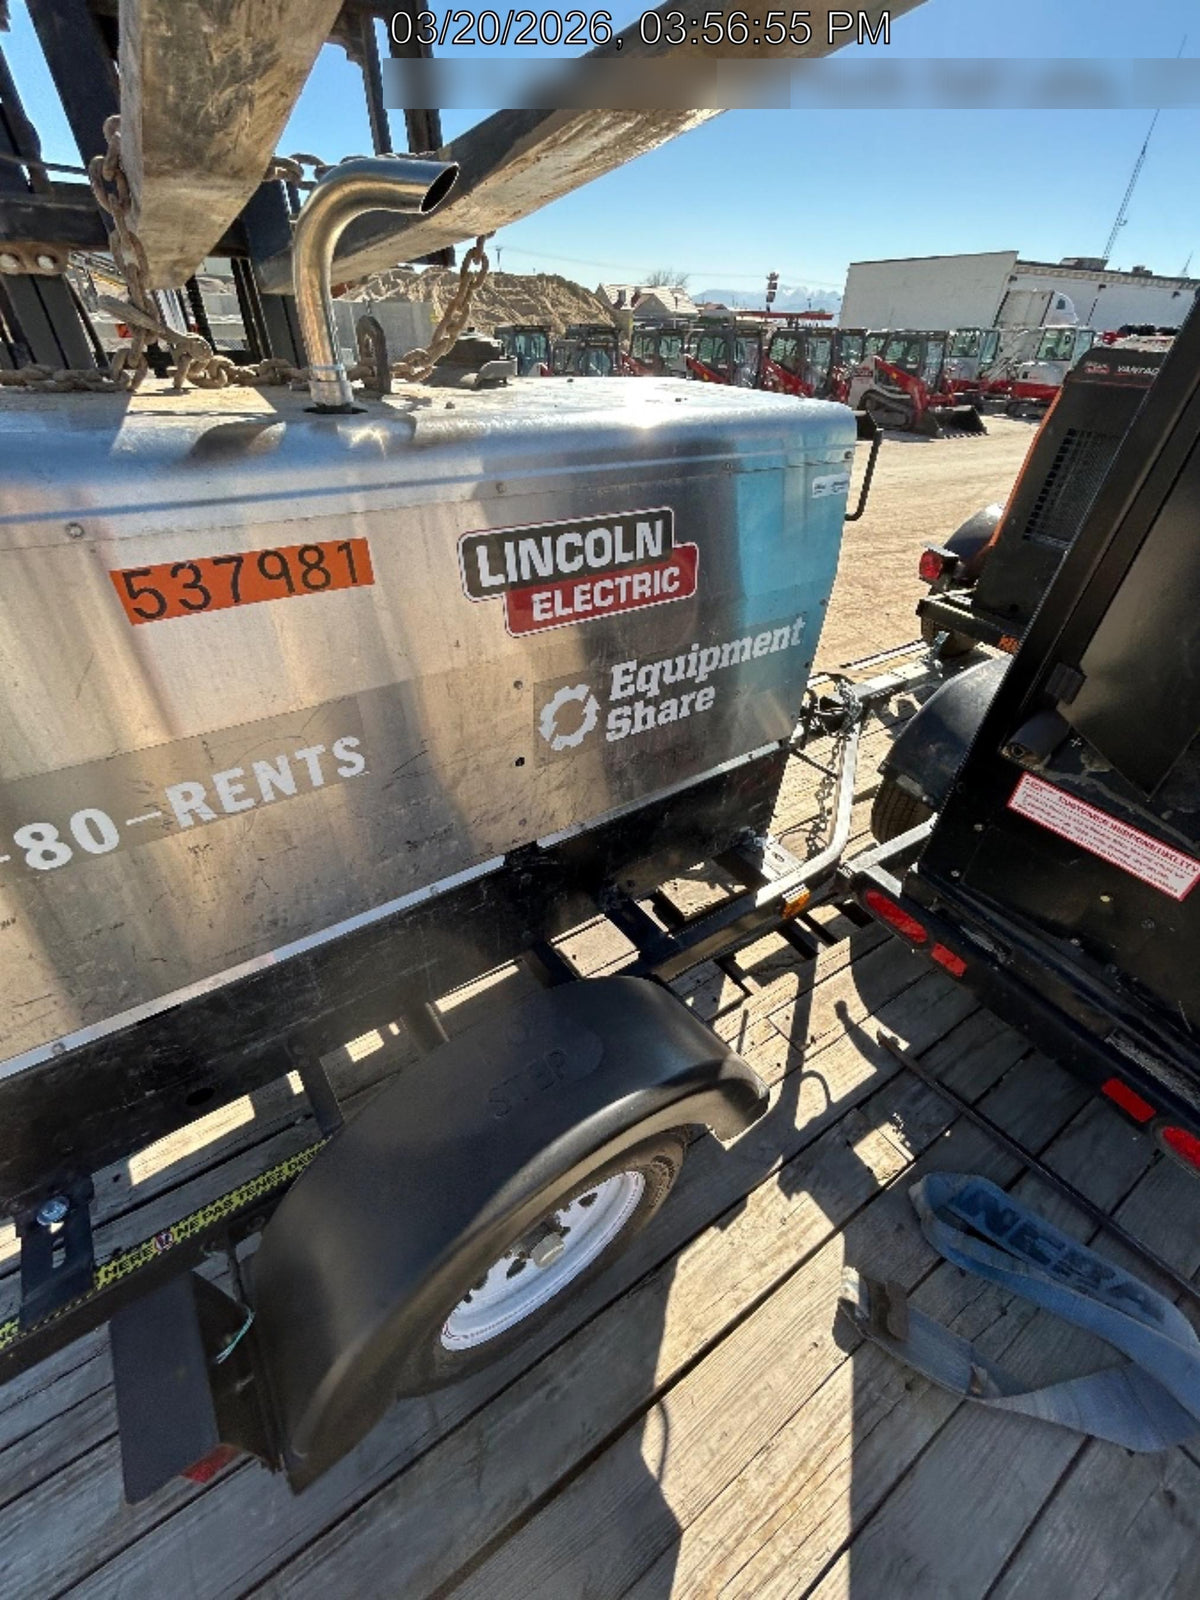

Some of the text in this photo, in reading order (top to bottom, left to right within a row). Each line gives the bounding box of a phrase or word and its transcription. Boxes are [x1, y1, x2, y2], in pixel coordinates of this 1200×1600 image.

[122, 541, 358, 620] 537981
[476, 520, 664, 588] LINCOLN
[531, 566, 680, 622] ELECTRIC
[609, 616, 806, 702] Equipment
[605, 685, 715, 742] Share
[203, 1199, 233, 1220] PAS
